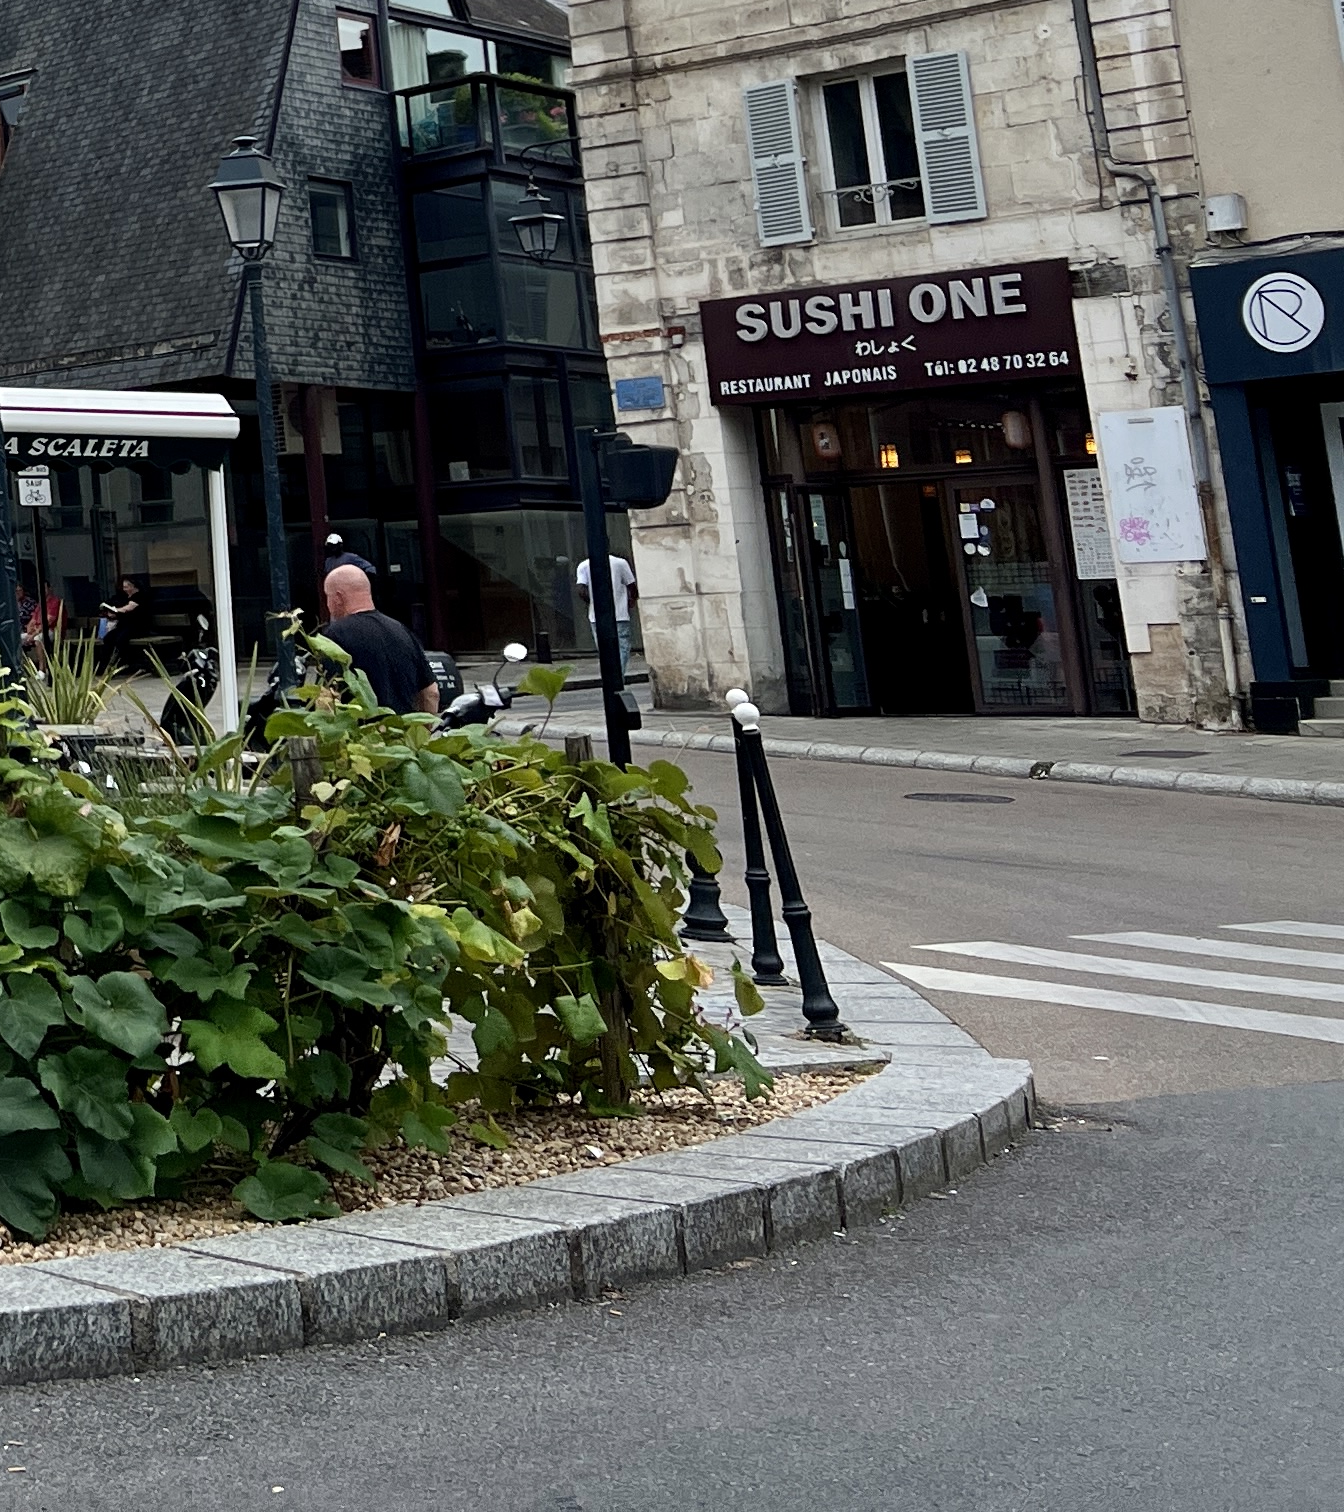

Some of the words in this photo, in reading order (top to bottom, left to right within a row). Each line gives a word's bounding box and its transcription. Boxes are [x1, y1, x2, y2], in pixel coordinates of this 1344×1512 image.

[735, 288, 895, 343] SUSHI
[909, 273, 1027, 323] ONE
[855, 335, 917, 357] わしょく
[719, 373, 812, 396] RESTAURANT
[824, 364, 898, 387] JAPONAIS
[957, 358, 978, 374] 02
[980, 356, 1000, 372] 48
[1003, 354, 1023, 370] 70
[1026, 352, 1046, 368] 32
[1048, 350, 1070, 366] 64
[4, 436, 19, 455] A
[27, 437, 150, 457] SCALETA
